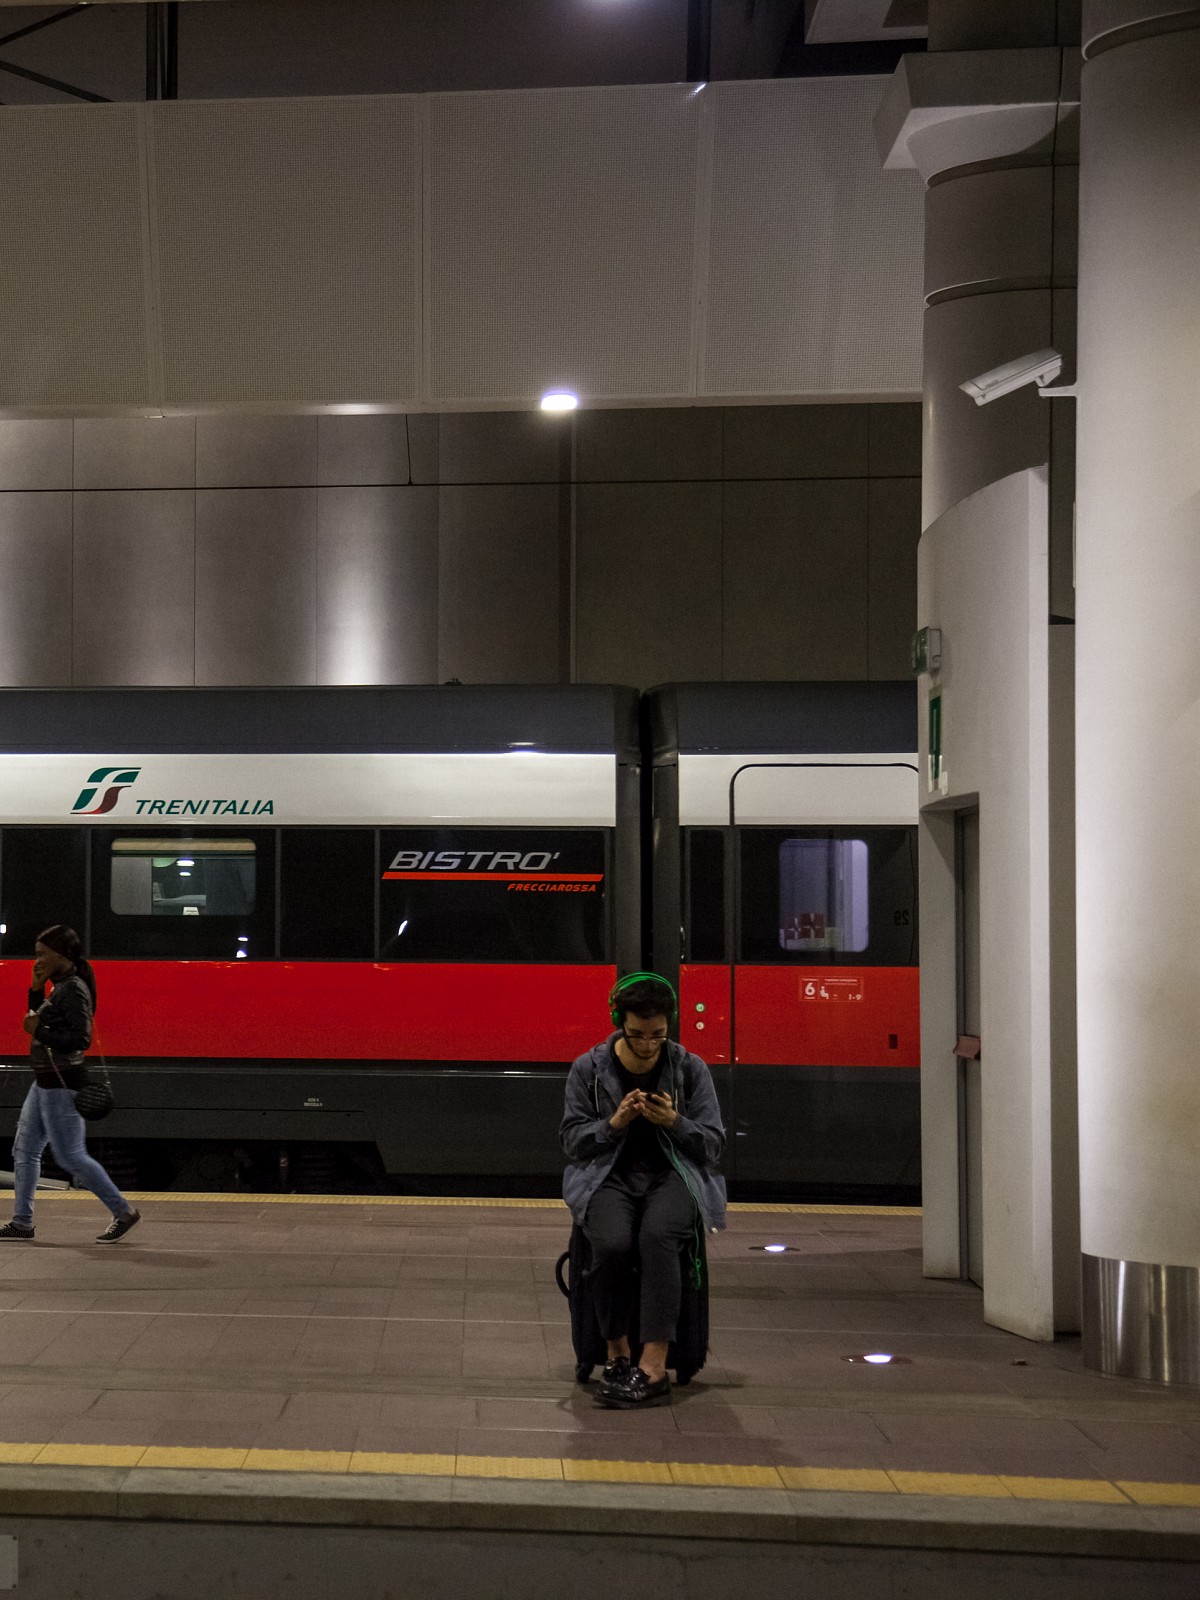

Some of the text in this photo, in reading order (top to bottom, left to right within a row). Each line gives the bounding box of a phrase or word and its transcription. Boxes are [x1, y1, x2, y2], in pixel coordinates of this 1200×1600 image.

[135, 799, 275, 815] TRENITALIA
[507, 883, 597, 892] FRECCIAROSSA
[804, 982, 816, 996] 6
